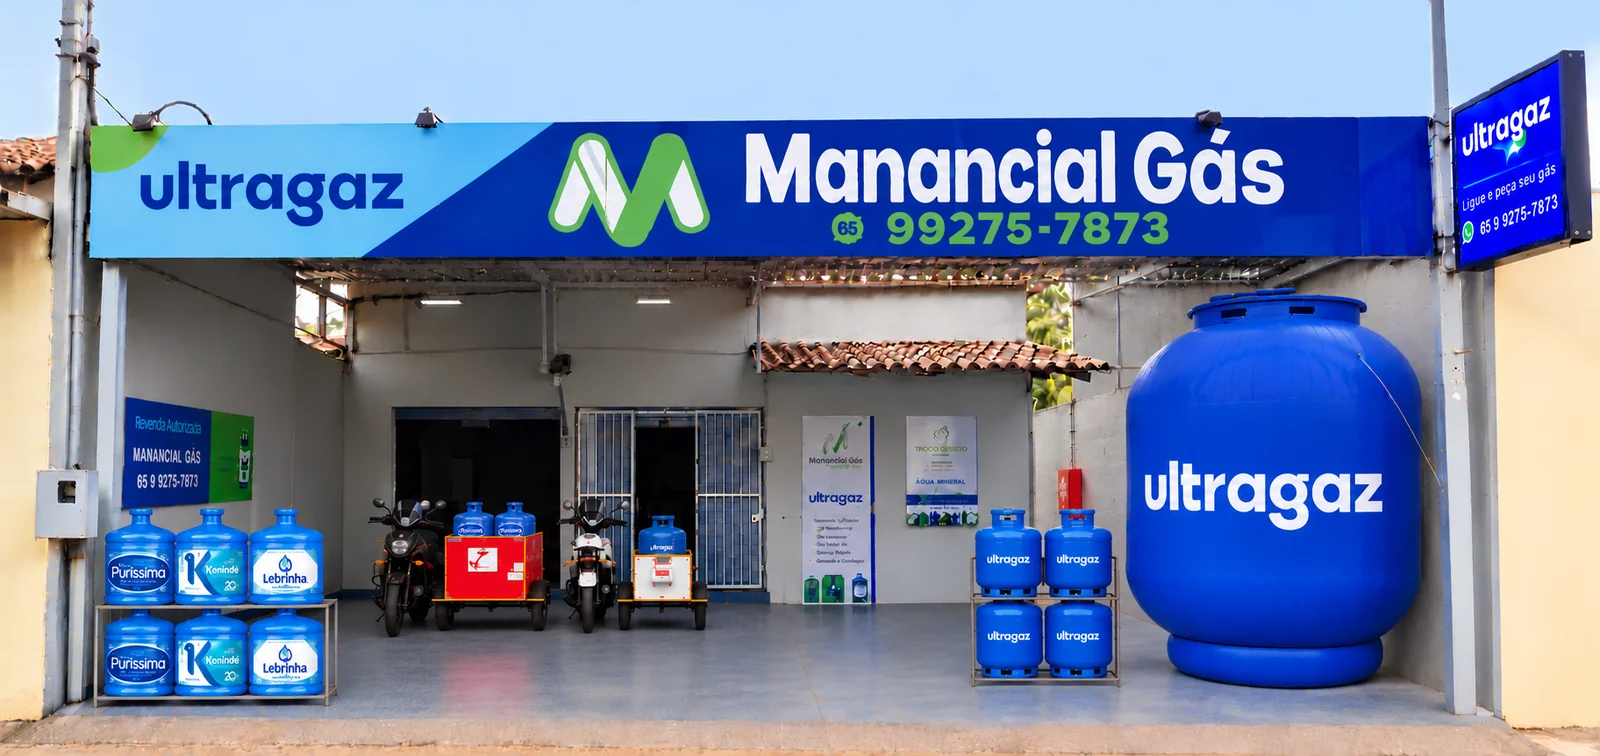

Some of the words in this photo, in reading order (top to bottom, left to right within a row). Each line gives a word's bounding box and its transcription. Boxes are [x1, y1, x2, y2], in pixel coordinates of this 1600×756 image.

[1461, 95, 1551, 157] ultragaz
[745, 129, 1116, 205] Manancial
[1133, 127, 1285, 205] Gás
[139, 160, 405, 227] ultragaz
[1462, 196, 1486, 212] Ligue
[1488, 192, 1493, 200] e
[1495, 183, 1517, 200] peça
[1518, 175, 1536, 188] seu
[1538, 162, 1556, 183] gás
[1480, 220, 1491, 235] 65
[1493, 216, 1499, 231] 9
[1502, 194, 1558, 227] 9275-7873
[837, 220, 859, 236] 65
[886, 211, 1170, 246] 99275-7873
[135, 415, 166, 431] Revenda
[166, 419, 202, 435] Autorizada
[133, 447, 182, 463] MANANCIAL
[184, 447, 201, 464] GÁS
[137, 474, 148, 489] 65
[150, 474, 156, 488] 9
[158, 474, 199, 488] 9275-7873
[809, 491, 863, 506] ultragaz
[1144, 460, 1383, 531] ultragaz
[986, 554, 1031, 567] ultragaz
[1056, 554, 1100, 567] ultragaz
[263, 573, 308, 584] Lebrinha
[987, 631, 1031, 644] ultragaz
[1056, 631, 1100, 644] ultragaz
[263, 662, 308, 674] Lebrinha
